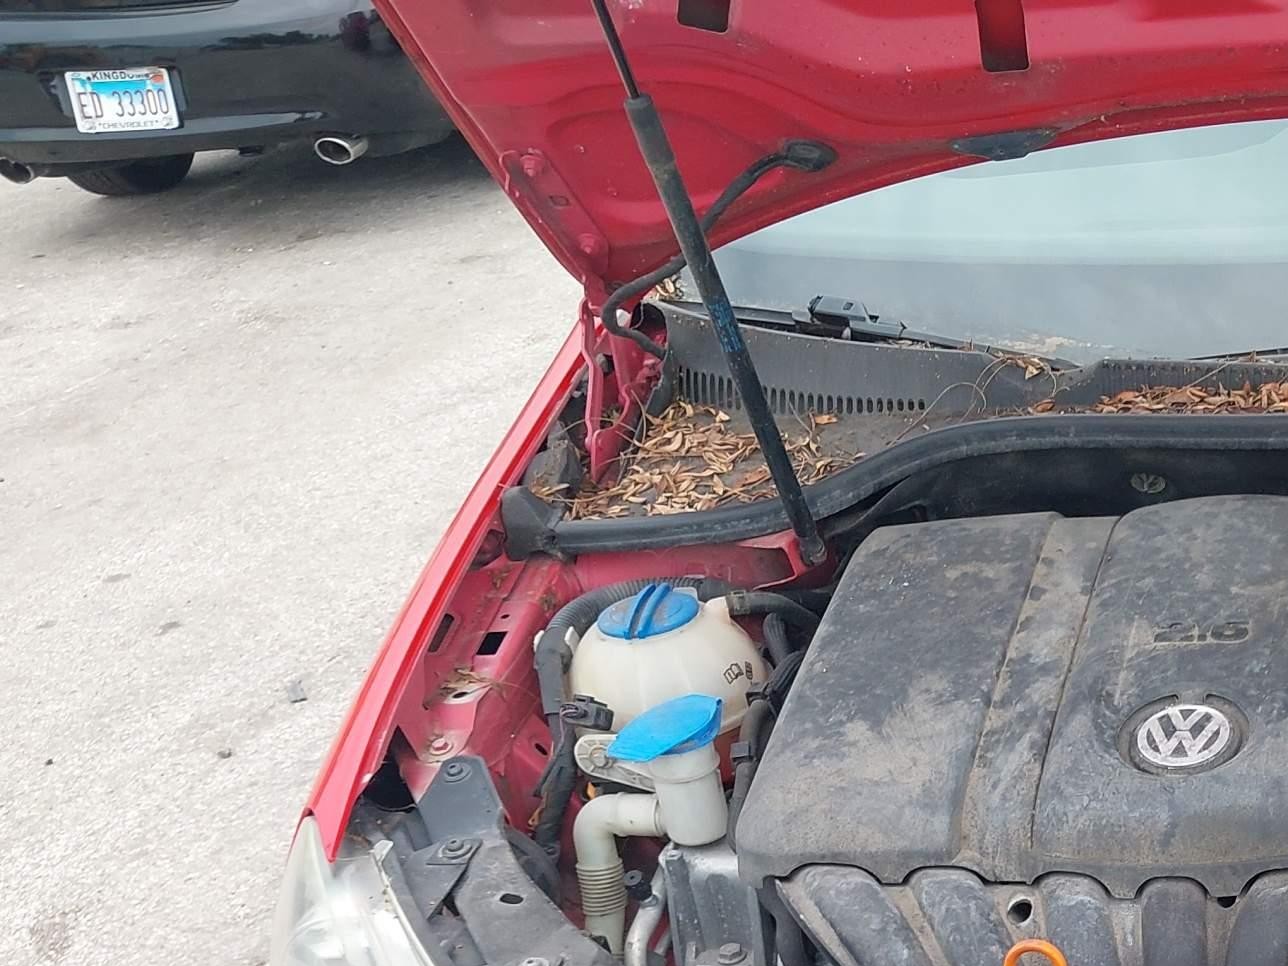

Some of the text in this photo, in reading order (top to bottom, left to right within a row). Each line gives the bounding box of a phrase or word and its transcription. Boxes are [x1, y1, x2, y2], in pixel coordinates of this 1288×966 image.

[77, 88, 169, 119] ED 33300
[102, 120, 154, 129] CHEVROLET
